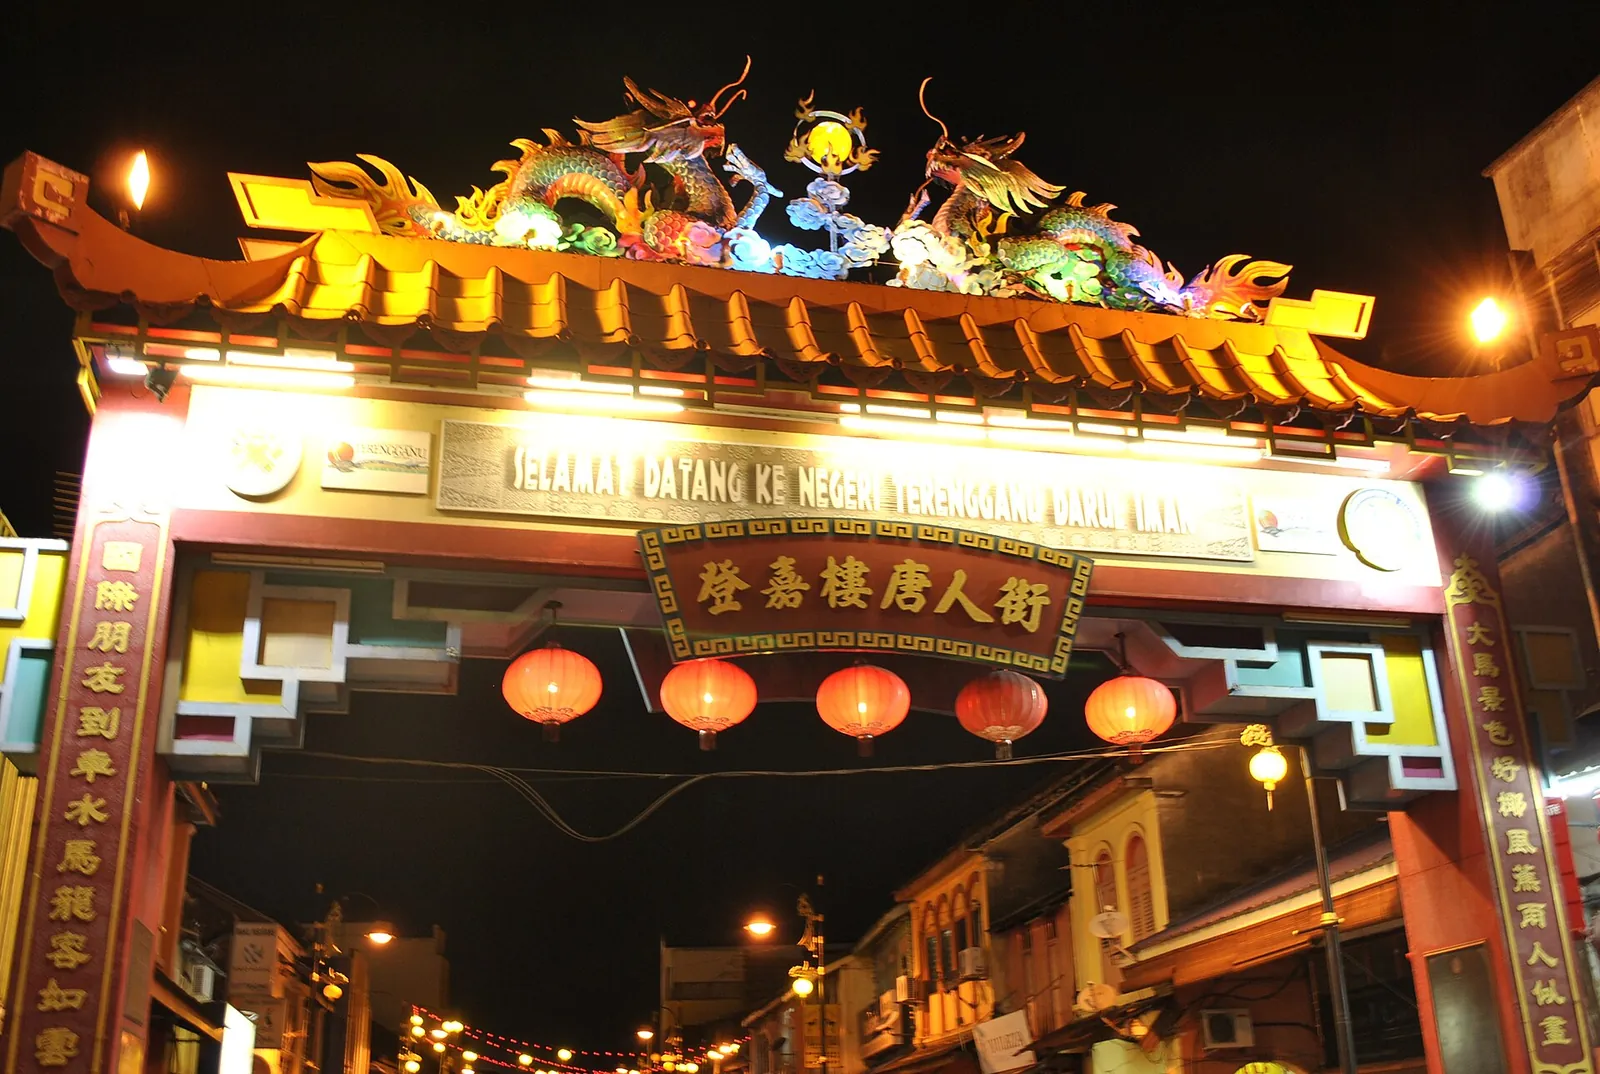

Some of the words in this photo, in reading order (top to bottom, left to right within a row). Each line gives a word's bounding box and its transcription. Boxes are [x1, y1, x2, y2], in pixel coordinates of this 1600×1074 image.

[513, 446, 633, 496] SELAMAT
[644, 456, 741, 504] DATANG
[755, 463, 786, 506] KE
[799, 465, 880, 512] NEGERI
[894, 474, 1044, 523] TERENGGANU
[1053, 486, 1127, 530] DARUL
[1134, 490, 1197, 534] IMAN
[697, 555, 1051, 633] 登嘉樓唐人街
